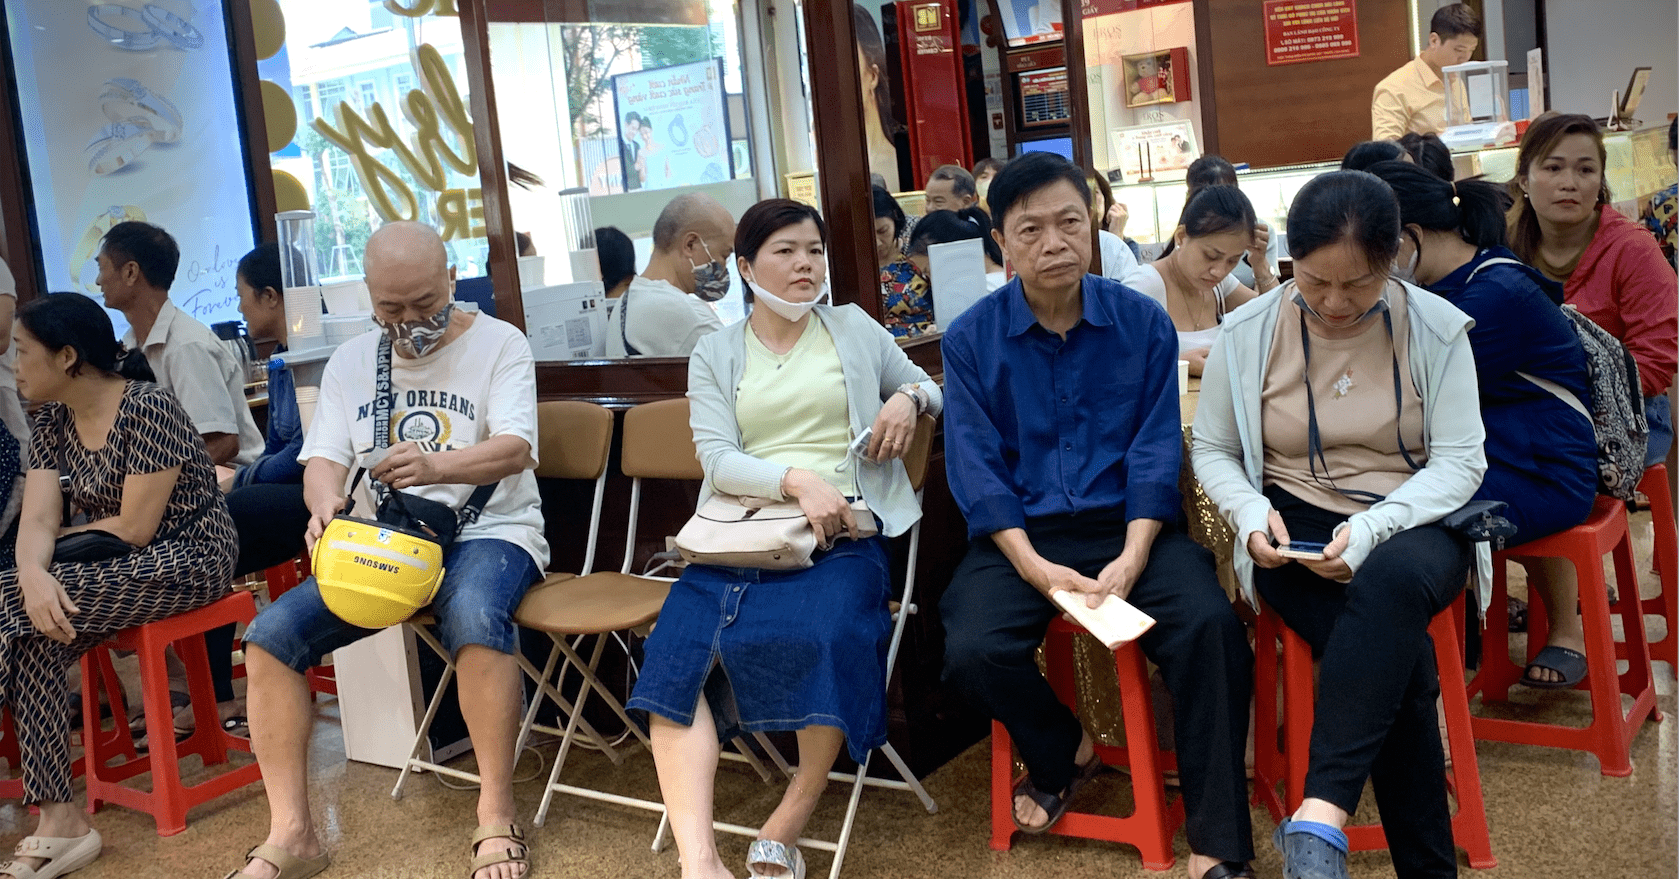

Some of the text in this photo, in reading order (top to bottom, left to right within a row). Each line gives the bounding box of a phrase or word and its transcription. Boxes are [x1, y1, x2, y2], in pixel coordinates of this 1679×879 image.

[215, 276, 229, 288] is
[183, 289, 240, 318] Forev
[406, 390, 475, 421] ORLEANS
[354, 556, 399, 574] SAMSUNG
